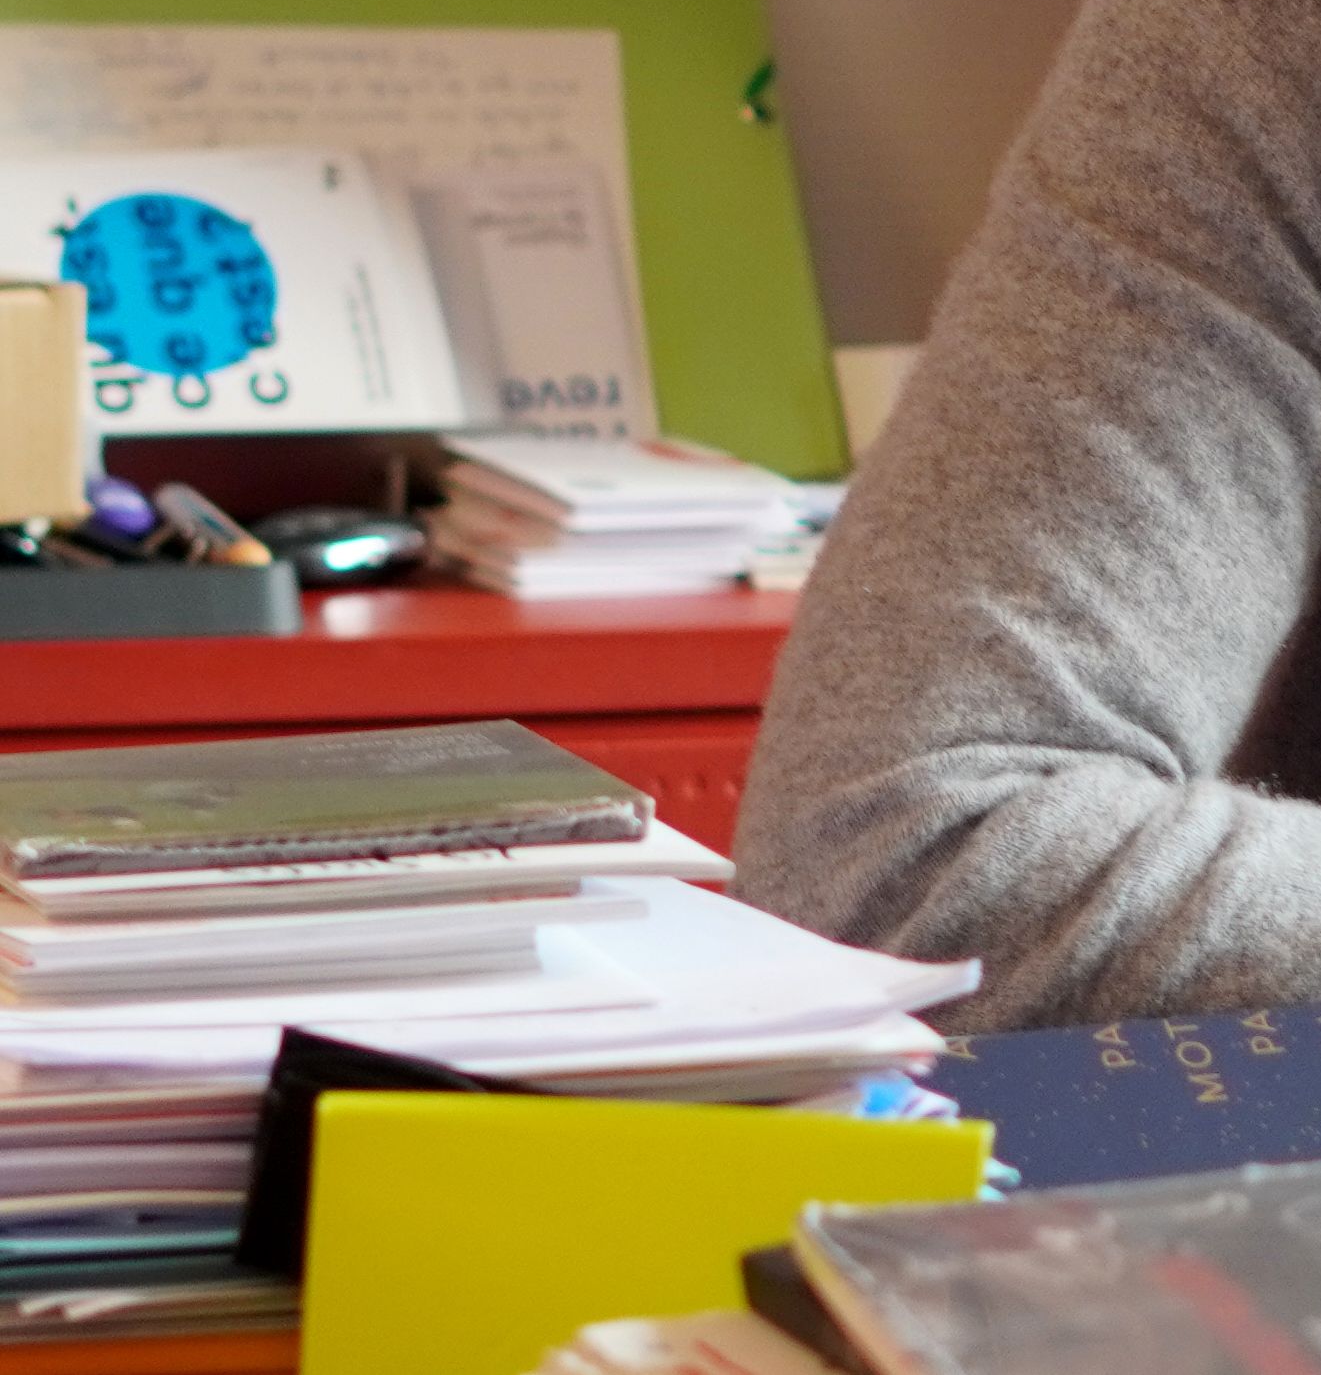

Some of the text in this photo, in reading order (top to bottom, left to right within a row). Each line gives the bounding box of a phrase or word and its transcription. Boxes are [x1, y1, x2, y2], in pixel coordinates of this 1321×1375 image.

[135, 198, 211, 409] ce que
[1093, 1021, 1137, 1068] PA
[1161, 1018, 1229, 1105] MOT
[1240, 1008, 1287, 1056] PA
